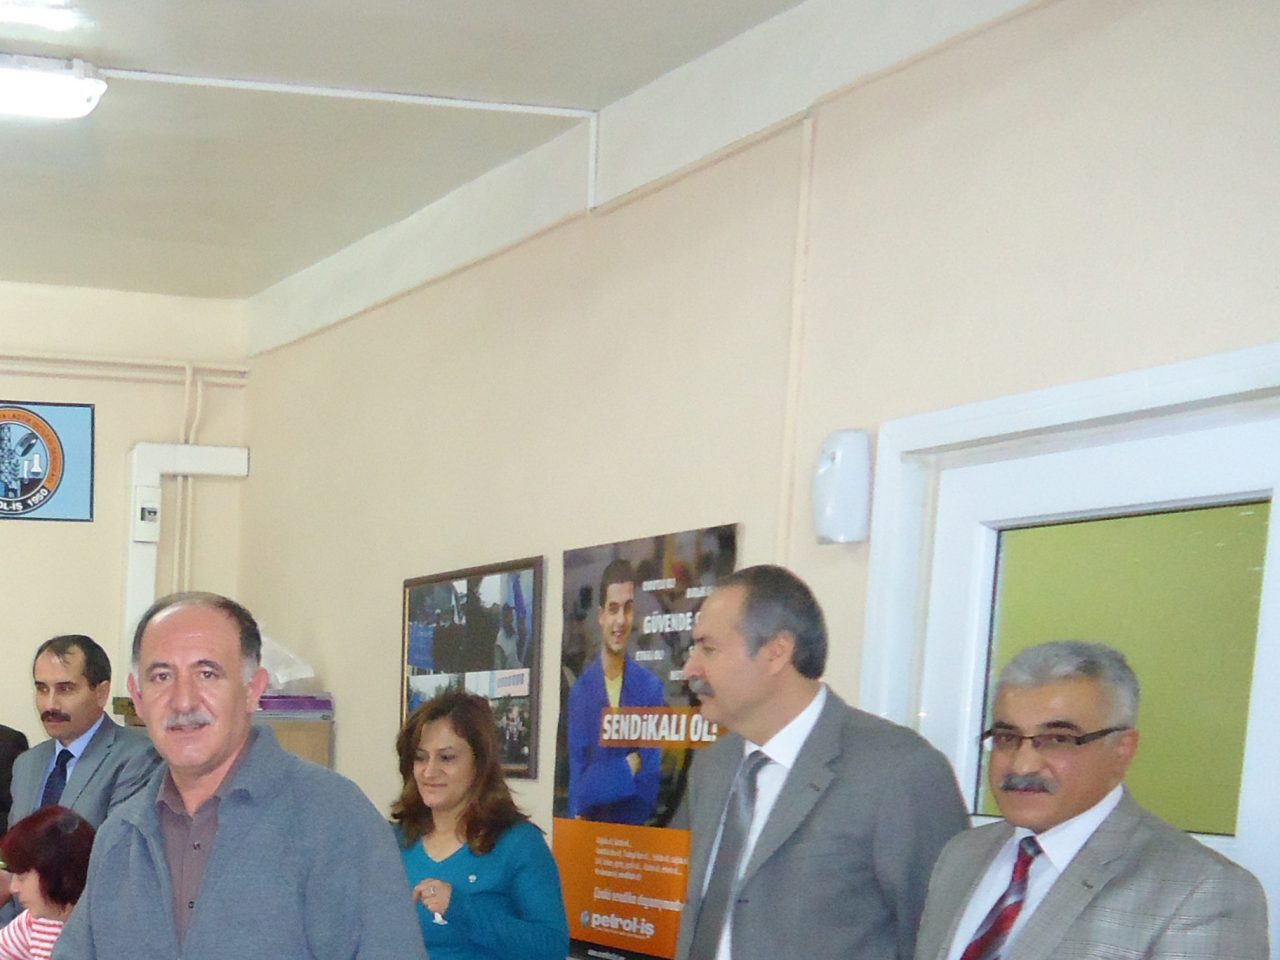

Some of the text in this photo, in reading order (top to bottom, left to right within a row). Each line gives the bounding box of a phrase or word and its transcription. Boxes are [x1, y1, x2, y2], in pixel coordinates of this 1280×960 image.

[27, 488, 48, 507] 1950
[643, 611, 693, 634] GÜVENDE
[690, 714, 718, 742] OL!
